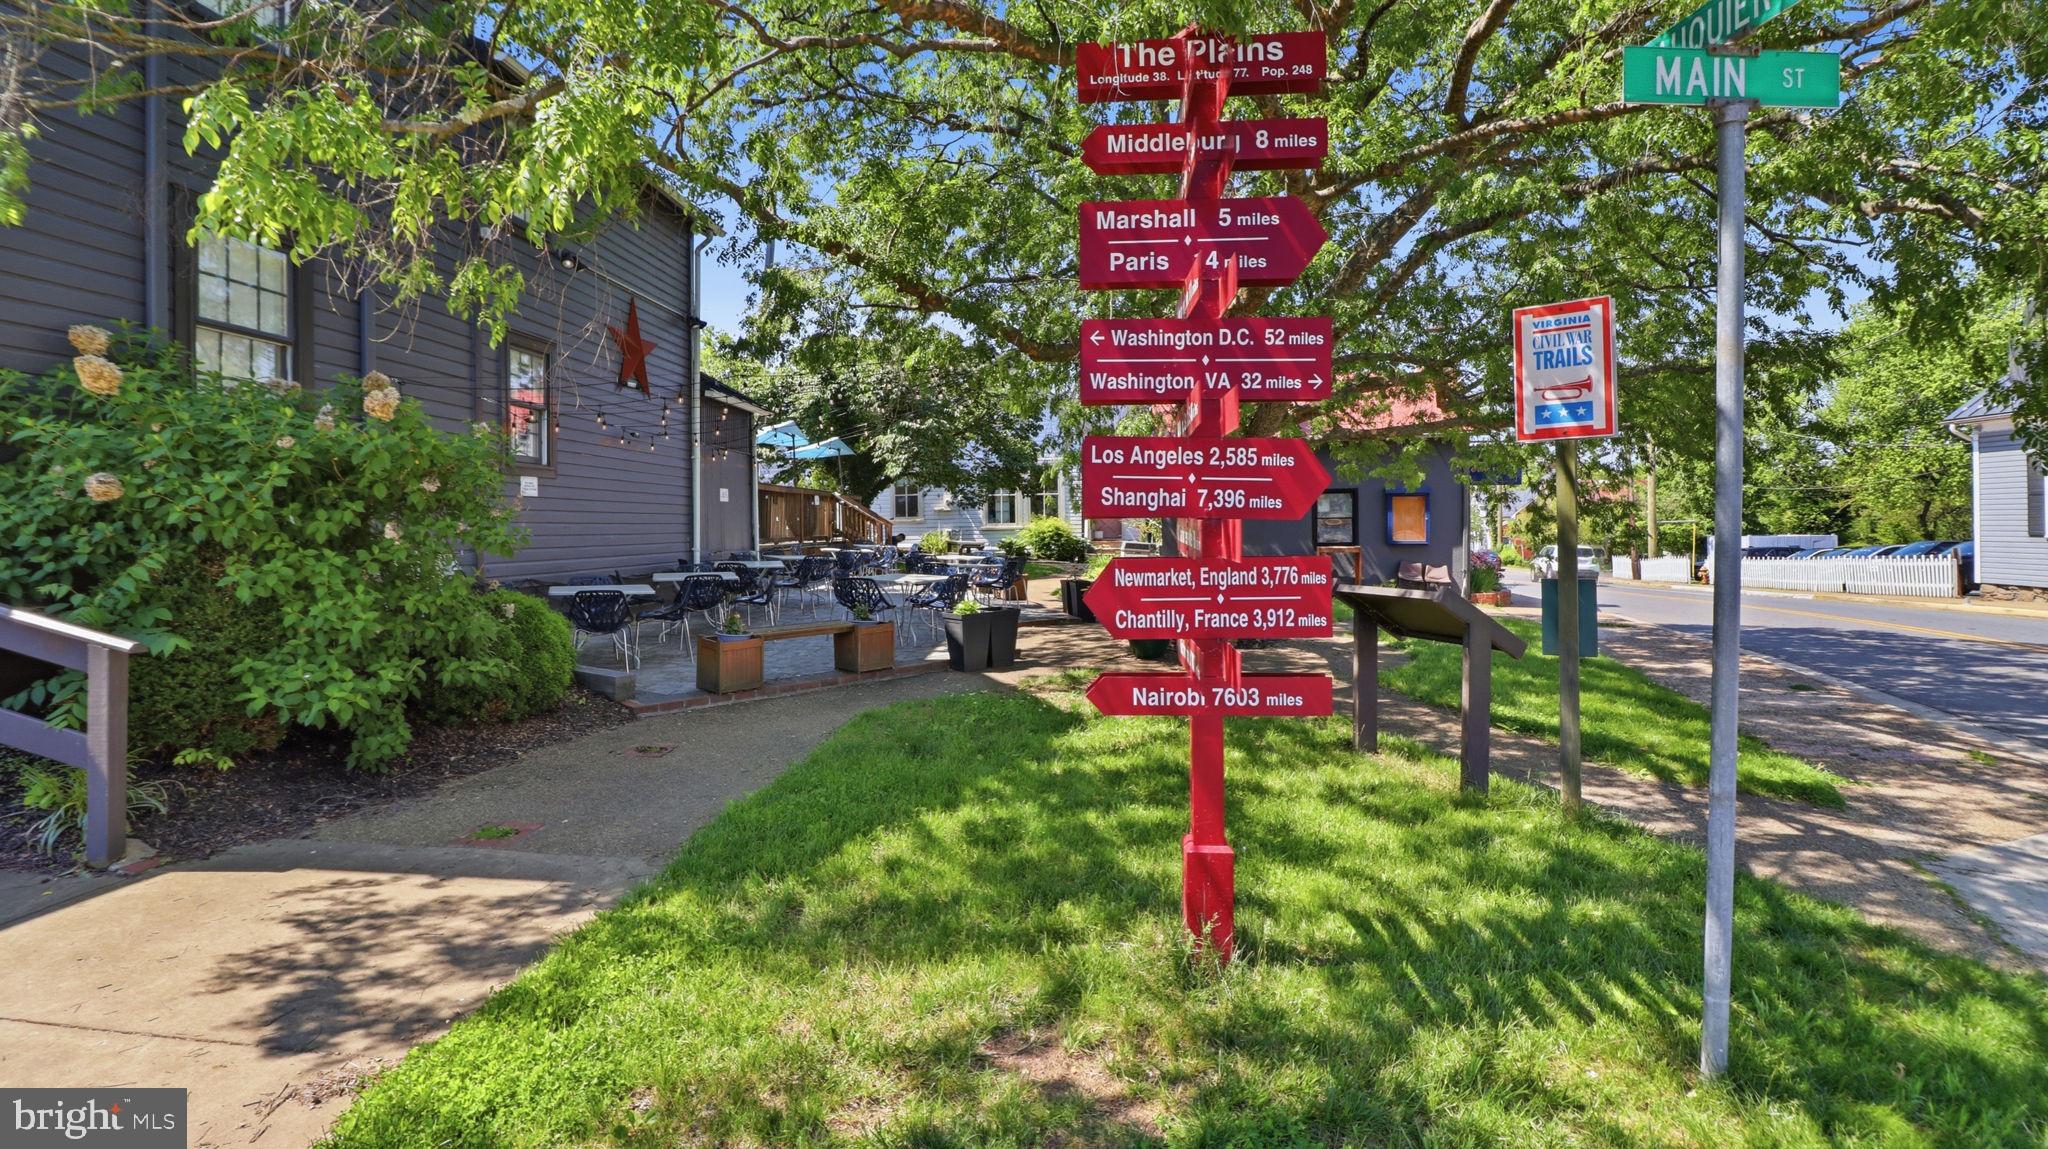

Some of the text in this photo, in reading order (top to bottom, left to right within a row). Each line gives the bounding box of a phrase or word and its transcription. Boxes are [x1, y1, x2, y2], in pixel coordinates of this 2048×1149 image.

[1117, 42, 1176, 68] The
[1091, 71, 1149, 86] Longitude
[1153, 72, 1169, 81] 38.
[1234, 68, 1248, 77] 77.
[1262, 67, 1288, 77] Pop.
[1293, 65, 1312, 74] 248
[1656, 56, 1805, 97] MAIN ST
[1256, 130, 1268, 148] 8
[1275, 135, 1316, 147] miles
[1097, 208, 1279, 229] Marshall 5 miles
[1111, 252, 1168, 271] Paris
[1206, 251, 1219, 268] 4
[1533, 314, 1591, 329] VIRGINIA
[1112, 329, 1323, 350] Washington D.C. 52 miles
[1532, 329, 1592, 350] CIVIL WAR
[1533, 345, 1593, 371] TRAILS
[1090, 373, 1301, 393] Washington VA 32 miles
[1092, 445, 1294, 469] Los Angeles 2,585 miles
[1102, 487, 1282, 511] Shanghai 7,396 miles
[1115, 567, 1326, 590] Newmarket, England 3,776 miles
[1116, 609, 1327, 632] Chantilly, France 3,912 miles
[1133, 688, 1302, 706] Nairobi 7603 miles
